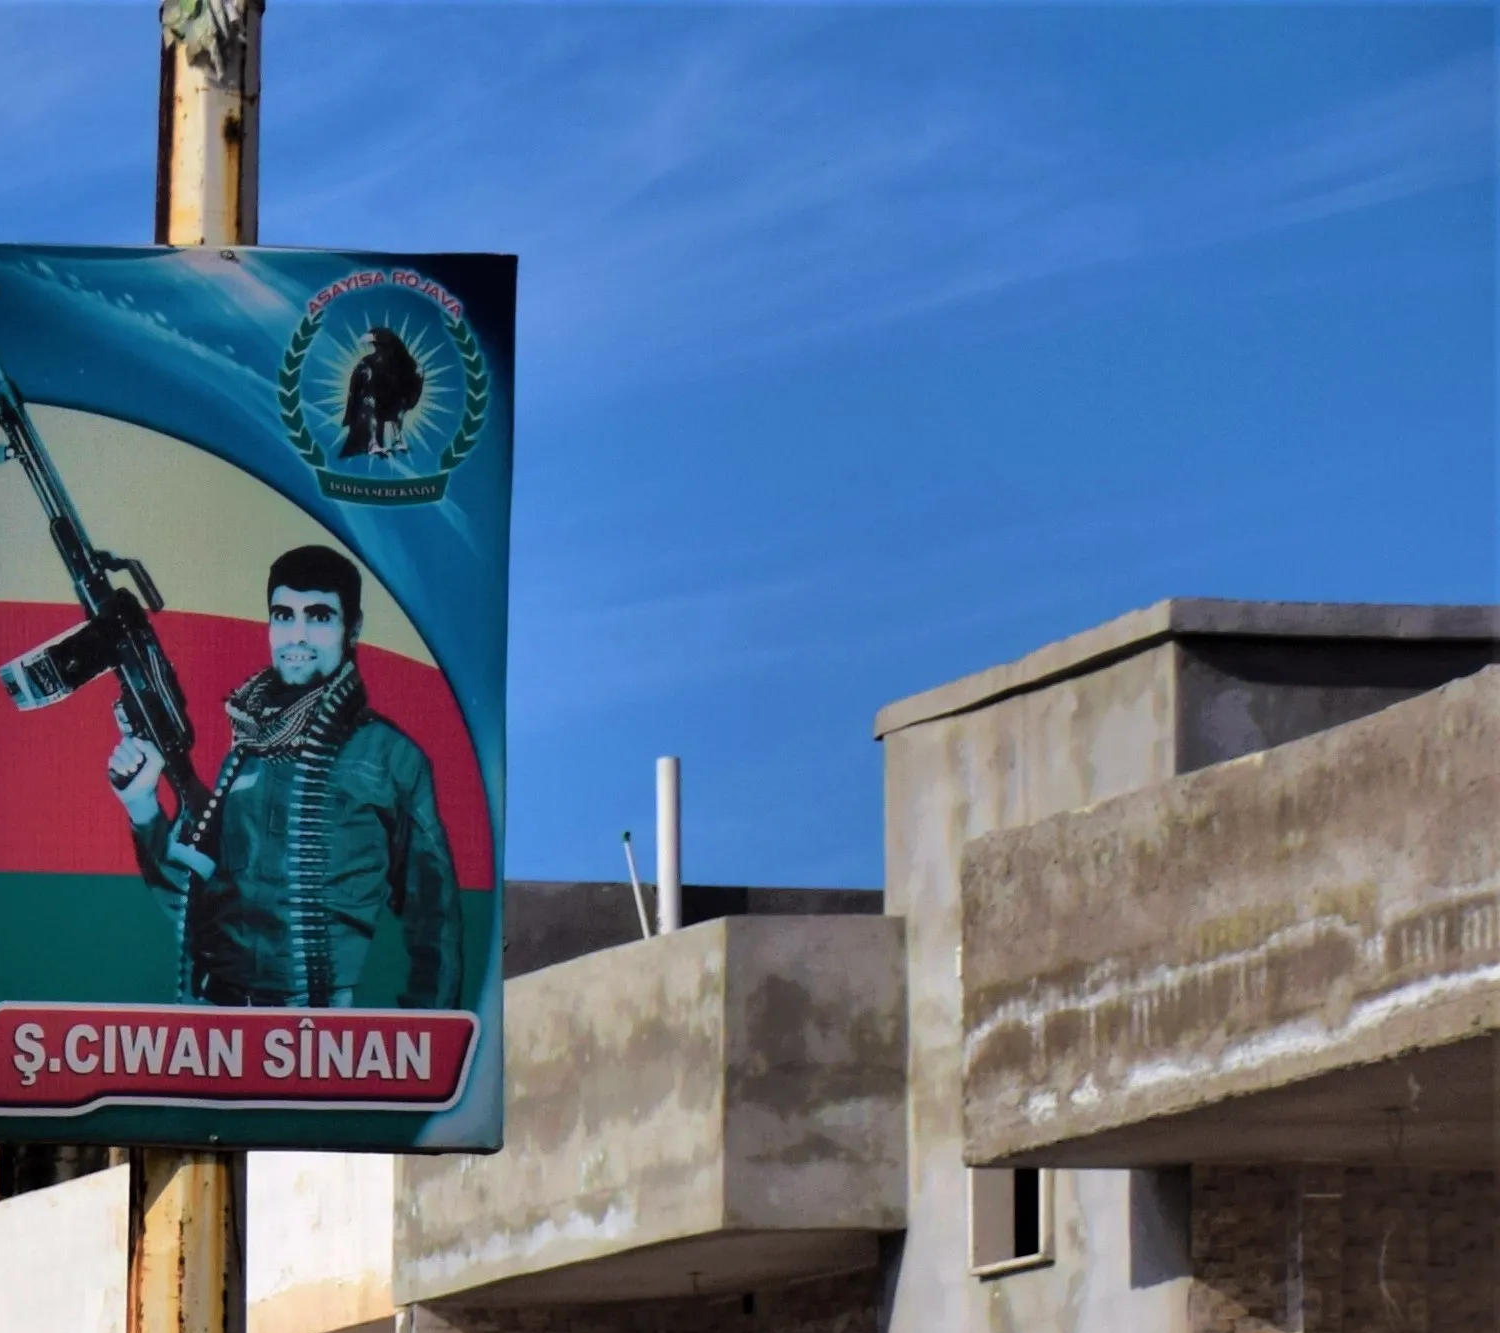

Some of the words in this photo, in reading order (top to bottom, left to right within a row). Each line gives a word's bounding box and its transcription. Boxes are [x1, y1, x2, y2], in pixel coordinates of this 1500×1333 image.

[392, 271, 463, 319] ROJAVA
[13, 1023, 244, 1085] Ş.CIWAN
[262, 1017, 432, 1080] SÎNAN
